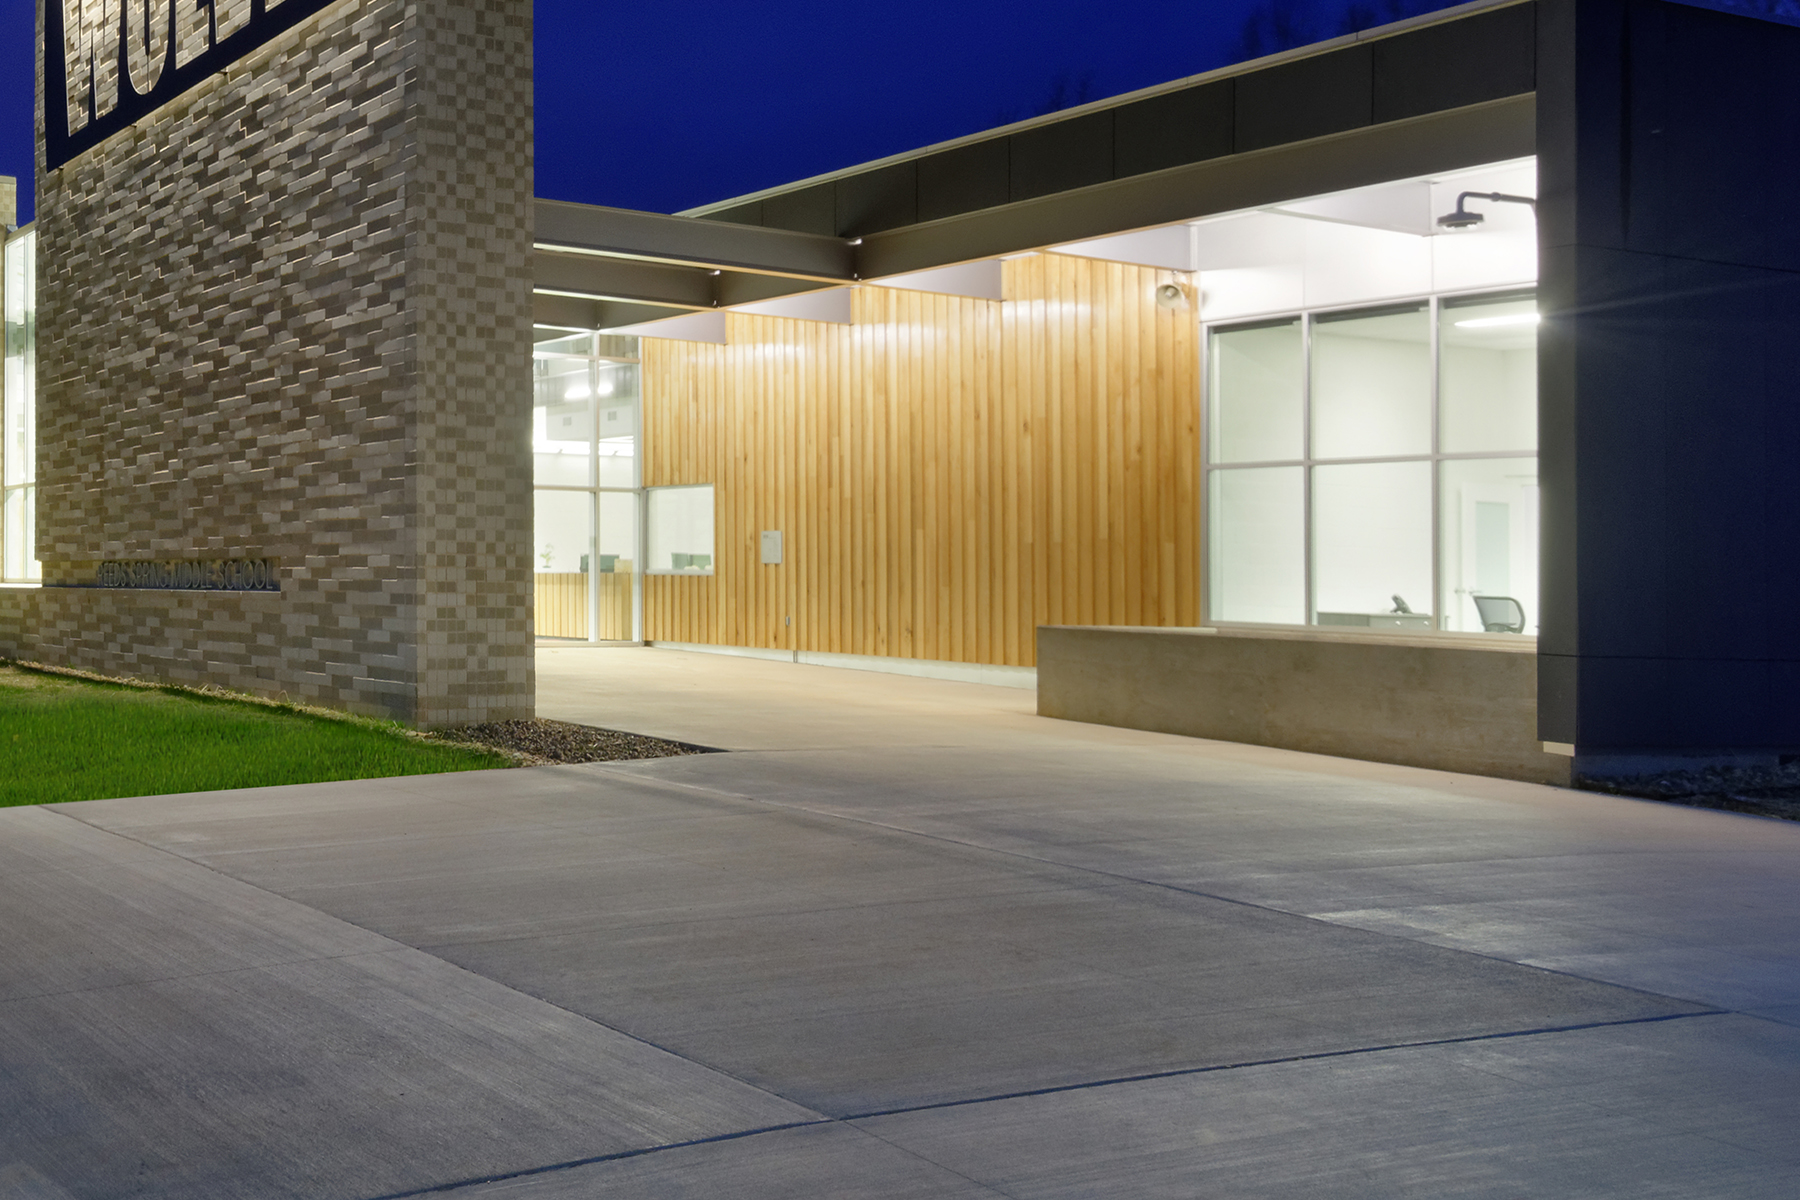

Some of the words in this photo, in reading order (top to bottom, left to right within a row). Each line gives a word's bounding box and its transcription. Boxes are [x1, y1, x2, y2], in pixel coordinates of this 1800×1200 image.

[98, 563, 126, 587] REEDS
[130, 562, 167, 588] SPRING
[170, 561, 212, 588] MIDDLE
[218, 560, 273, 589] SCHOOL
